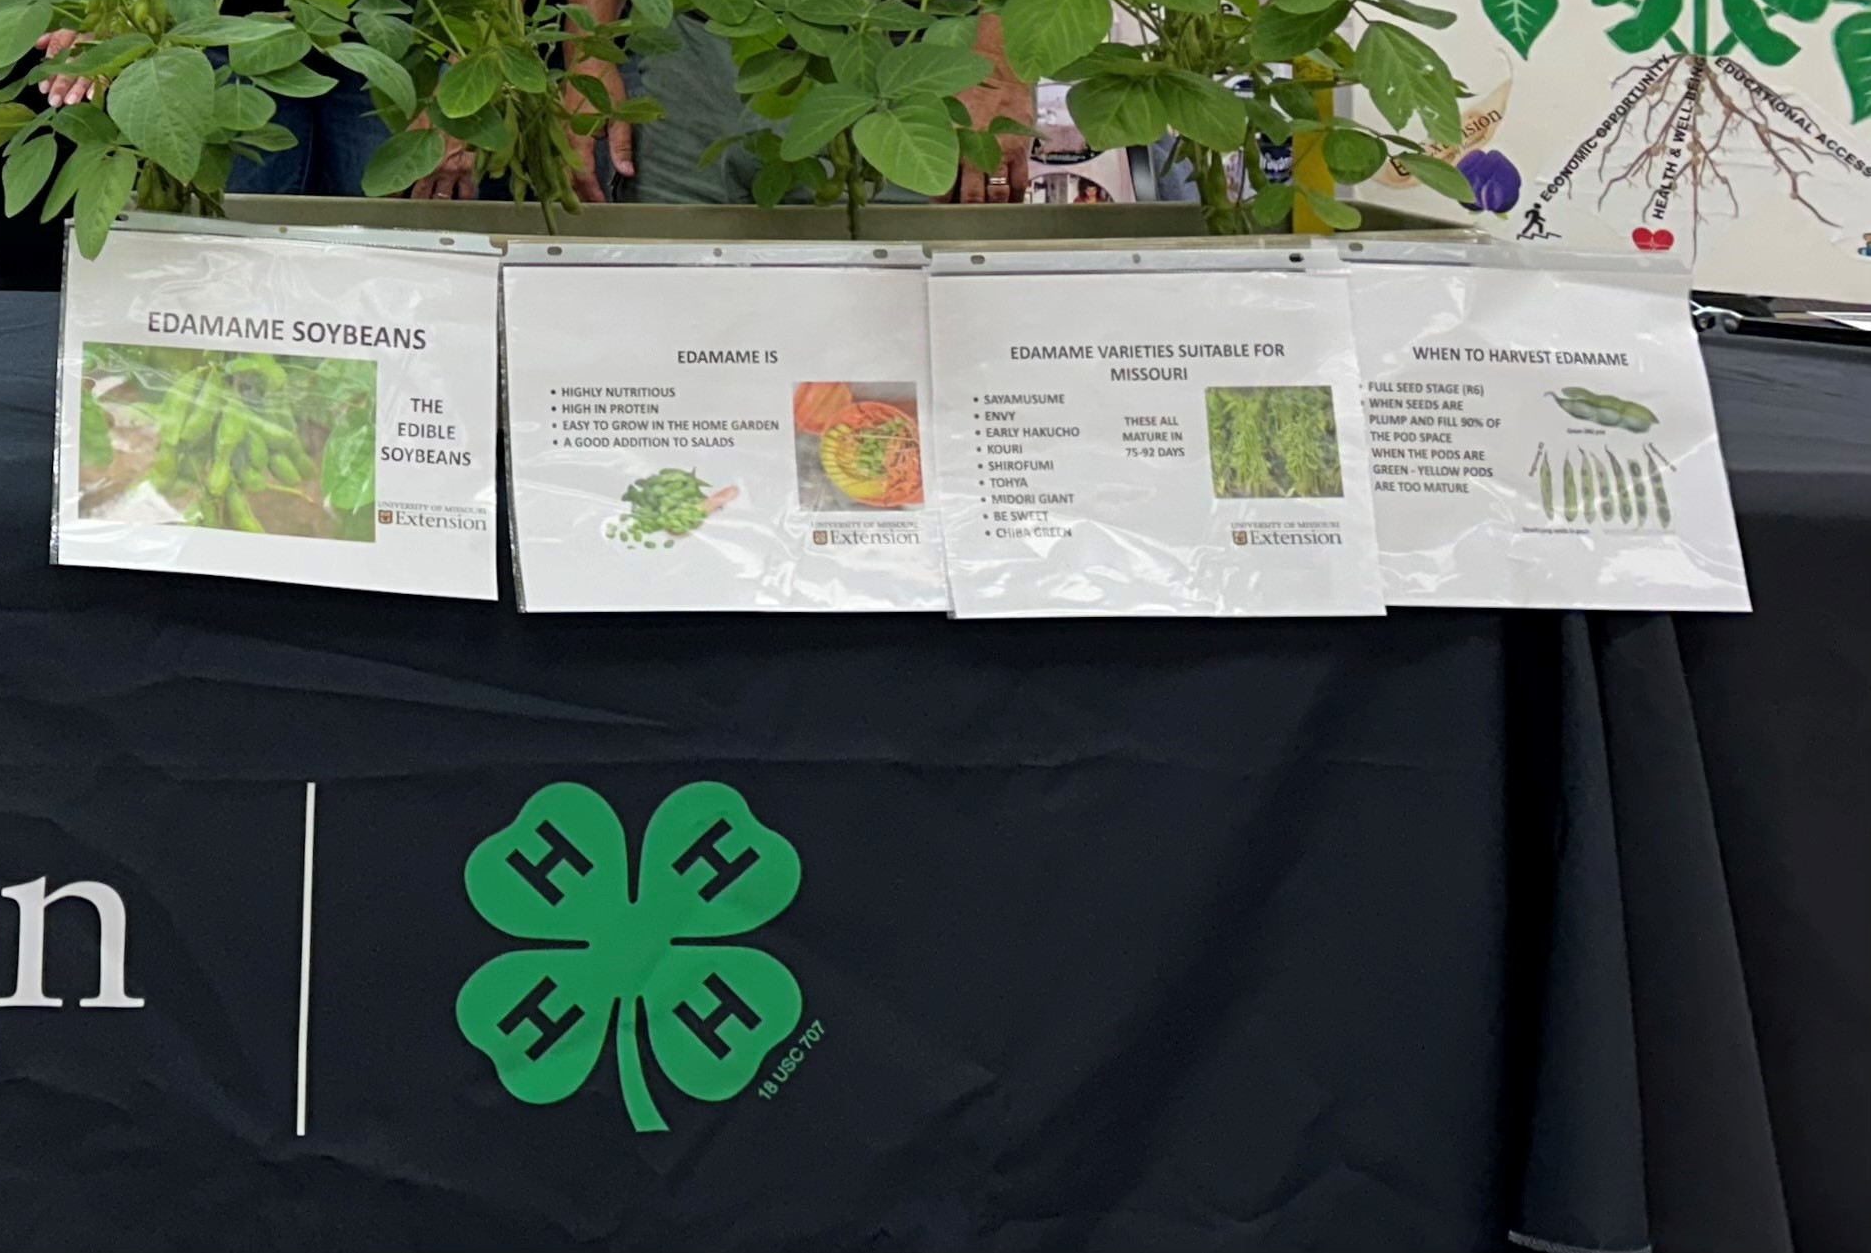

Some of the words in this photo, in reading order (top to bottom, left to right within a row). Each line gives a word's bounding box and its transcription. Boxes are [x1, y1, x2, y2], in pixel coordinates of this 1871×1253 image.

[1673, 55, 1706, 143] WELL-BEING
[1715, 56, 1813, 135] EDUCATIONAL
[1815, 133, 1871, 177] ACCESS
[1540, 136, 1598, 202] ECONOMIC
[1596, 54, 1670, 138] OPPORTUNITY
[1670, 148, 1682, 159] &
[1652, 162, 1678, 220] HEALTH
[148, 311, 284, 340] EDAMAME
[292, 320, 425, 349] SOYBEANS
[677, 350, 759, 363] EDAMAME
[765, 350, 777, 363] IS
[1010, 345, 1093, 359] EDAMAME
[1097, 344, 1173, 358] VARIETIES
[1178, 343, 1249, 357] SUITABLE
[1253, 343, 1284, 356] FOR
[1412, 346, 1460, 360] WHEN
[1464, 348, 1484, 361] TO
[1489, 349, 1550, 363] HARVEST
[1554, 351, 1628, 366] EDAMAME
[1110, 367, 1187, 381] MISSOURI
[561, 386, 602, 397] HIGHLY
[605, 387, 675, 397] NUTRITIOUS
[1367, 381, 1393, 392] FULL
[1396, 382, 1423, 393] SEED
[1425, 383, 1459, 394] STAGE
[410, 397, 442, 413] THE
[983, 393, 1064, 404] SAYAMUSUME
[1368, 398, 1402, 408] WHEN
[1405, 398, 1439, 410] SEEDS
[1441, 400, 1463, 410] ARE
[561, 403, 590, 413] HIGH
[594, 403, 606, 413] IN
[609, 403, 658, 413] PROTEIN
[984, 411, 1015, 421] ENVY
[1124, 416, 1156, 426] THESE
[1159, 416, 1178, 425] ALL
[397, 422, 455, 439] EDIBLE
[562, 420, 589, 430] EASY
[592, 420, 608, 430] TO
[611, 420, 648, 430] GROW
[652, 420, 664, 430] IN
[667, 420, 688, 430] THE
[692, 420, 727, 430] HOME
[731, 420, 779, 430] GARDEN
[985, 427, 1019, 437] EARLY
[1022, 426, 1079, 437] HAKUCHO
[563, 437, 572, 447] A
[574, 436, 609, 447] GOOD
[612, 436, 669, 447] ADDITION
[672, 437, 688, 447] TO
[691, 436, 734, 447] SALADS
[1122, 431, 1167, 441] MATURE
[1170, 431, 1182, 440] IN
[381, 446, 470, 465] SOYBEANS
[1157, 447, 1184, 457] DAYS
[988, 460, 1053, 471] SHIROFUMI
[989, 477, 1028, 487] TOHYA
[395, 510, 486, 531] Extension
[829, 529, 919, 544] Extension
[1249, 529, 1342, 544] Extension
[505, 820, 594, 907] H
[672, 817, 761, 903] H
[496, 975, 585, 1062] H
[672, 972, 762, 1061] H
[757, 1079, 778, 1101] 18
[772, 1046, 805, 1084] USC
[798, 1020, 826, 1051] 707
